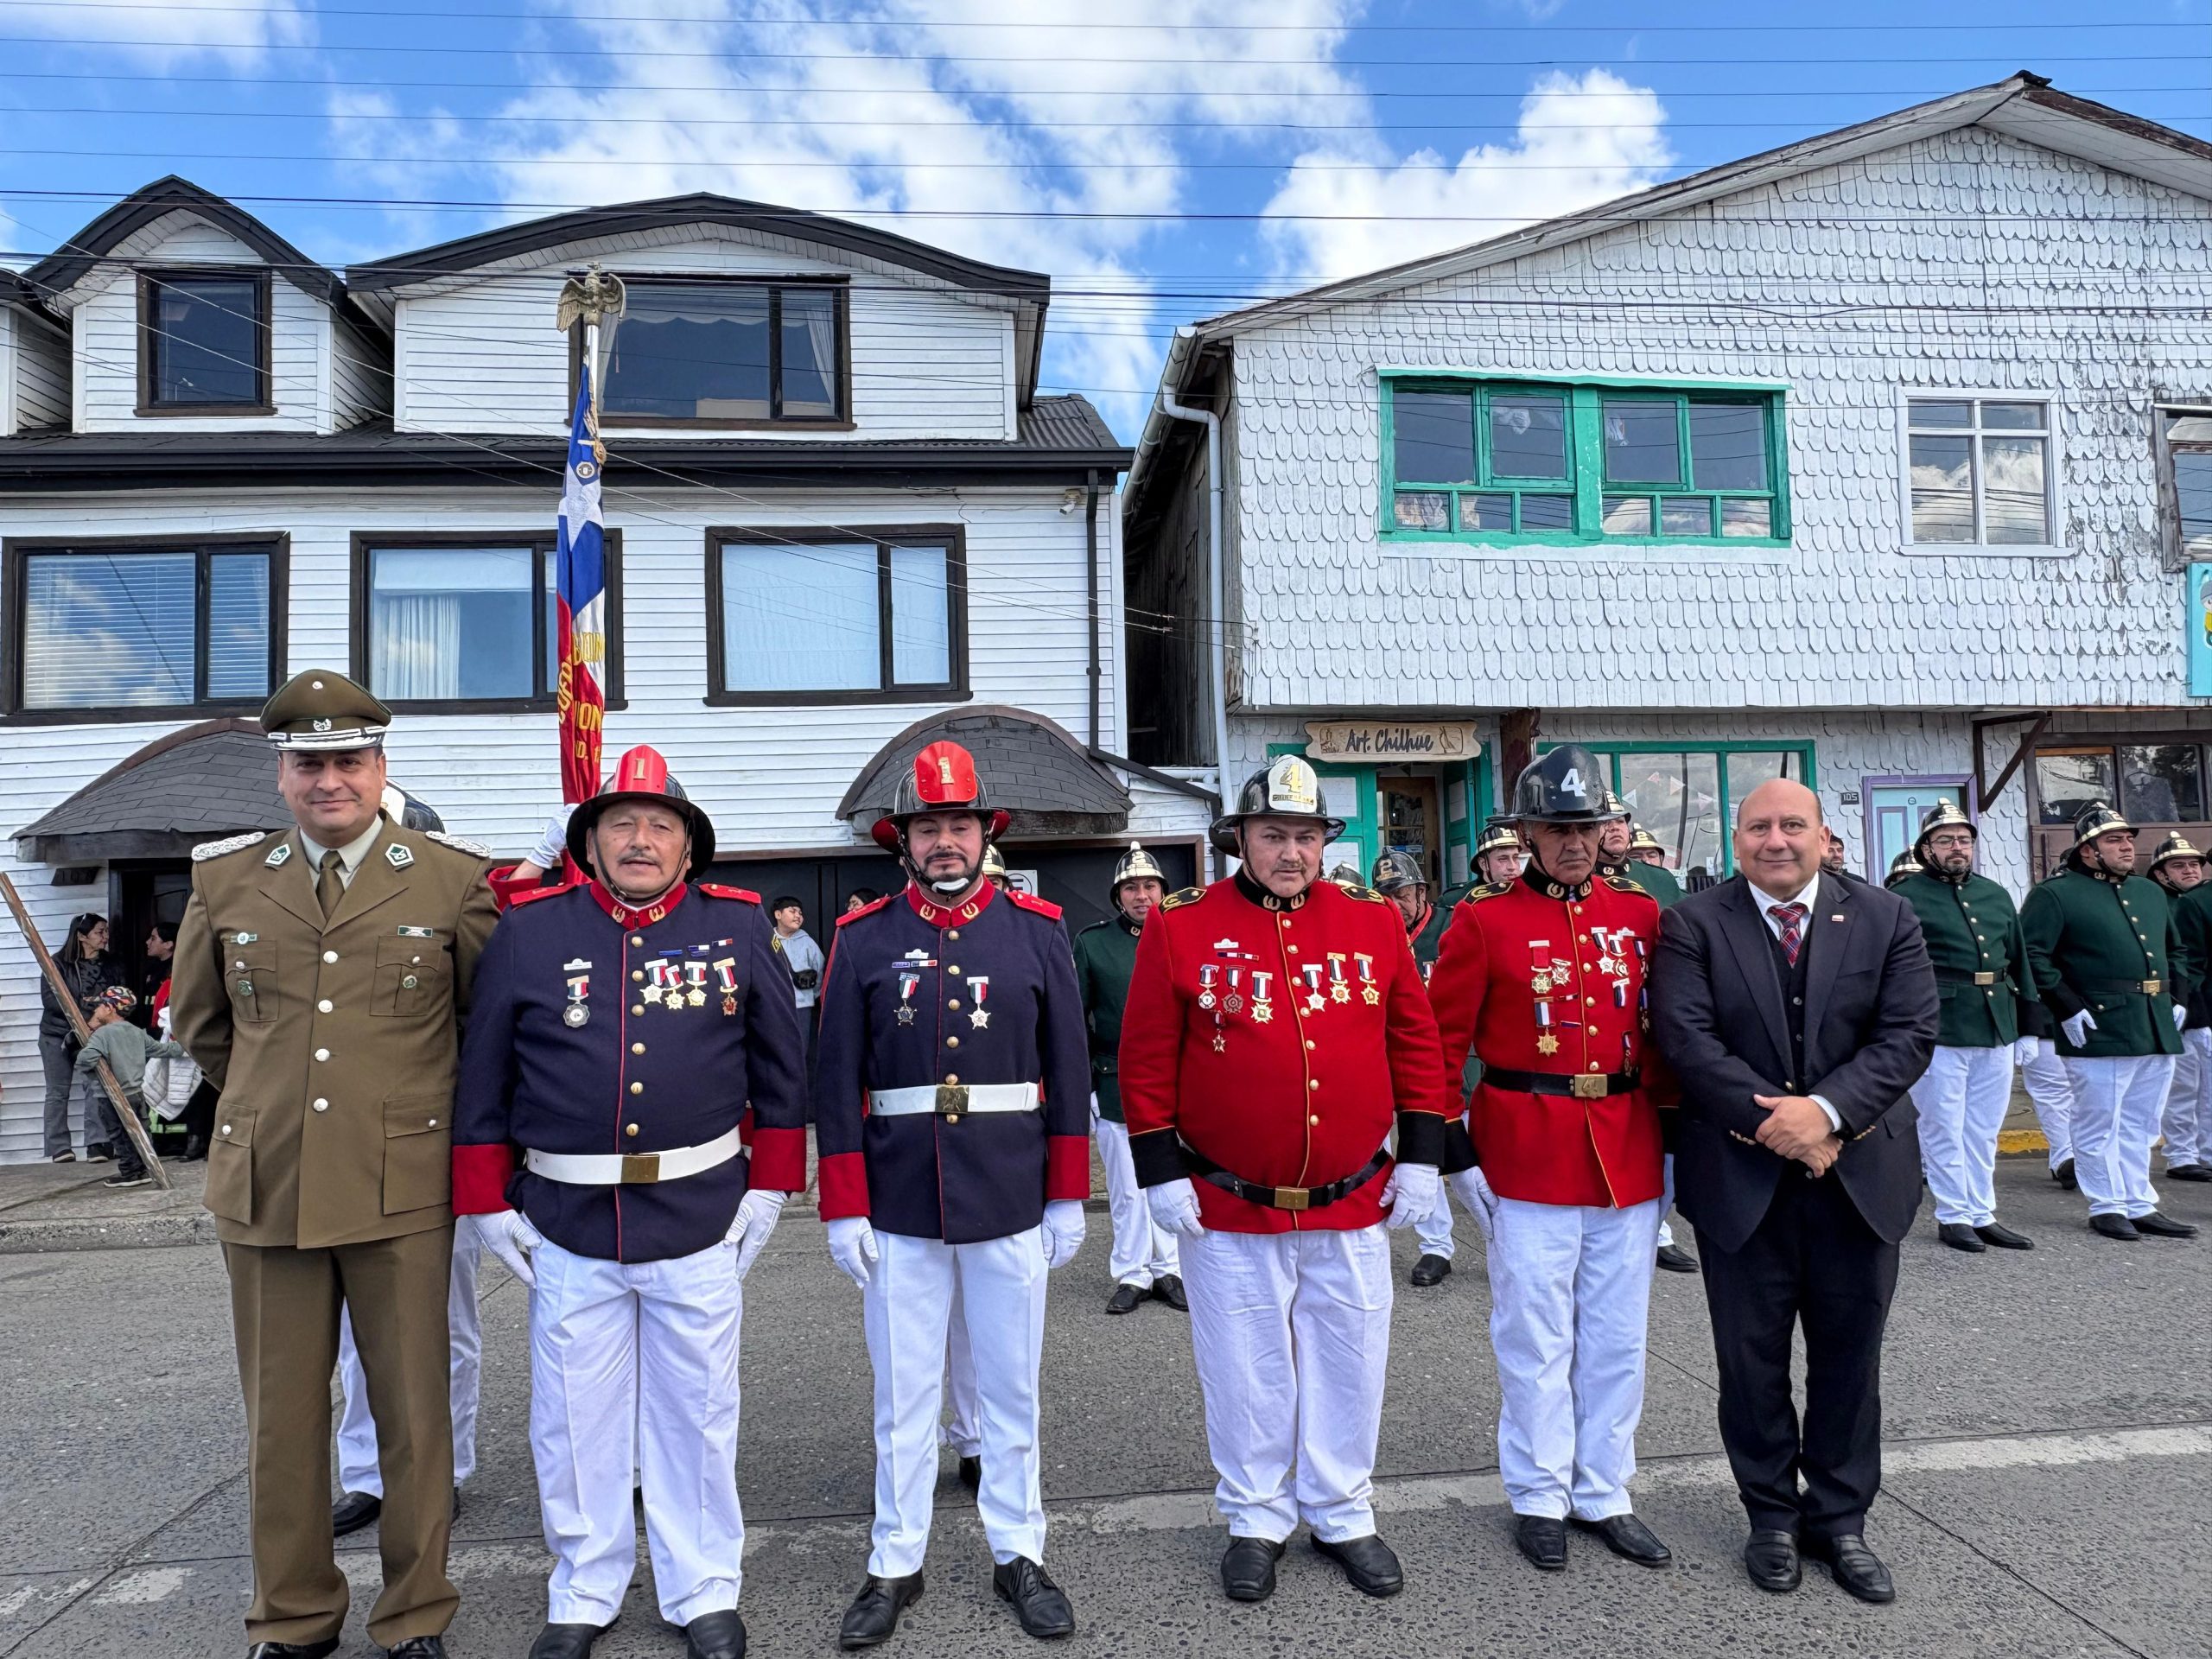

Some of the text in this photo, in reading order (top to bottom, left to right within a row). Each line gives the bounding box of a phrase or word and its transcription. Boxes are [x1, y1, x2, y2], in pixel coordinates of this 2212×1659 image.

[1345, 728, 1434, 753] Art. Chilhue
[633, 758, 646, 780] 1
[938, 756, 954, 785] 1
[1280, 764, 1302, 793] 4
[1560, 768, 1586, 797] 4
[1842, 792, 1858, 801] 105
[2175, 839, 2190, 849] 2
[1132, 851, 1147, 864] 2
[1379, 859, 1393, 873] 2
